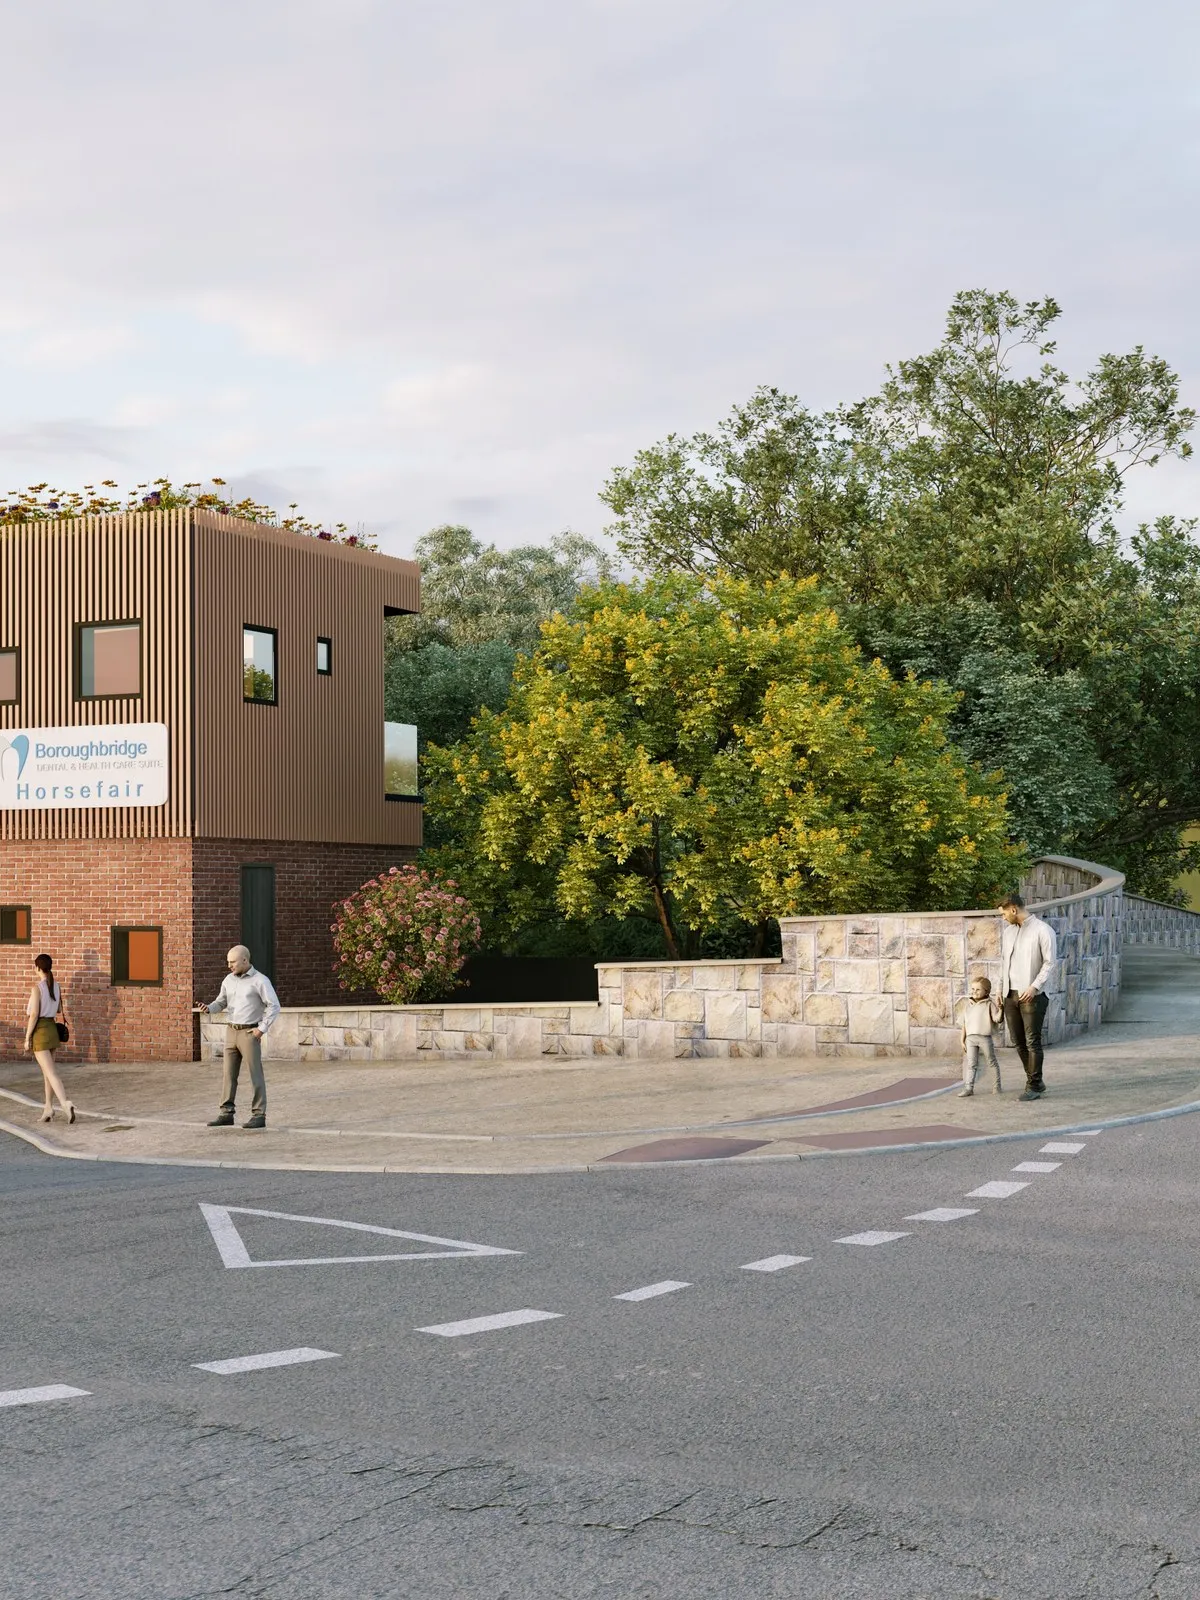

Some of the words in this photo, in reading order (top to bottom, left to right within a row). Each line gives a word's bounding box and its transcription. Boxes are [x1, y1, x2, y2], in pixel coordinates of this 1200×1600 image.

[36, 740, 147, 760] Boroughbridge
[36, 763, 68, 772] DENTAL
[70, 763, 77, 771] &
[79, 762, 111, 771] HEALTH
[113, 760, 136, 770] CARE
[139, 759, 164, 769] SUITE
[16, 780, 144, 800] Horsefair
